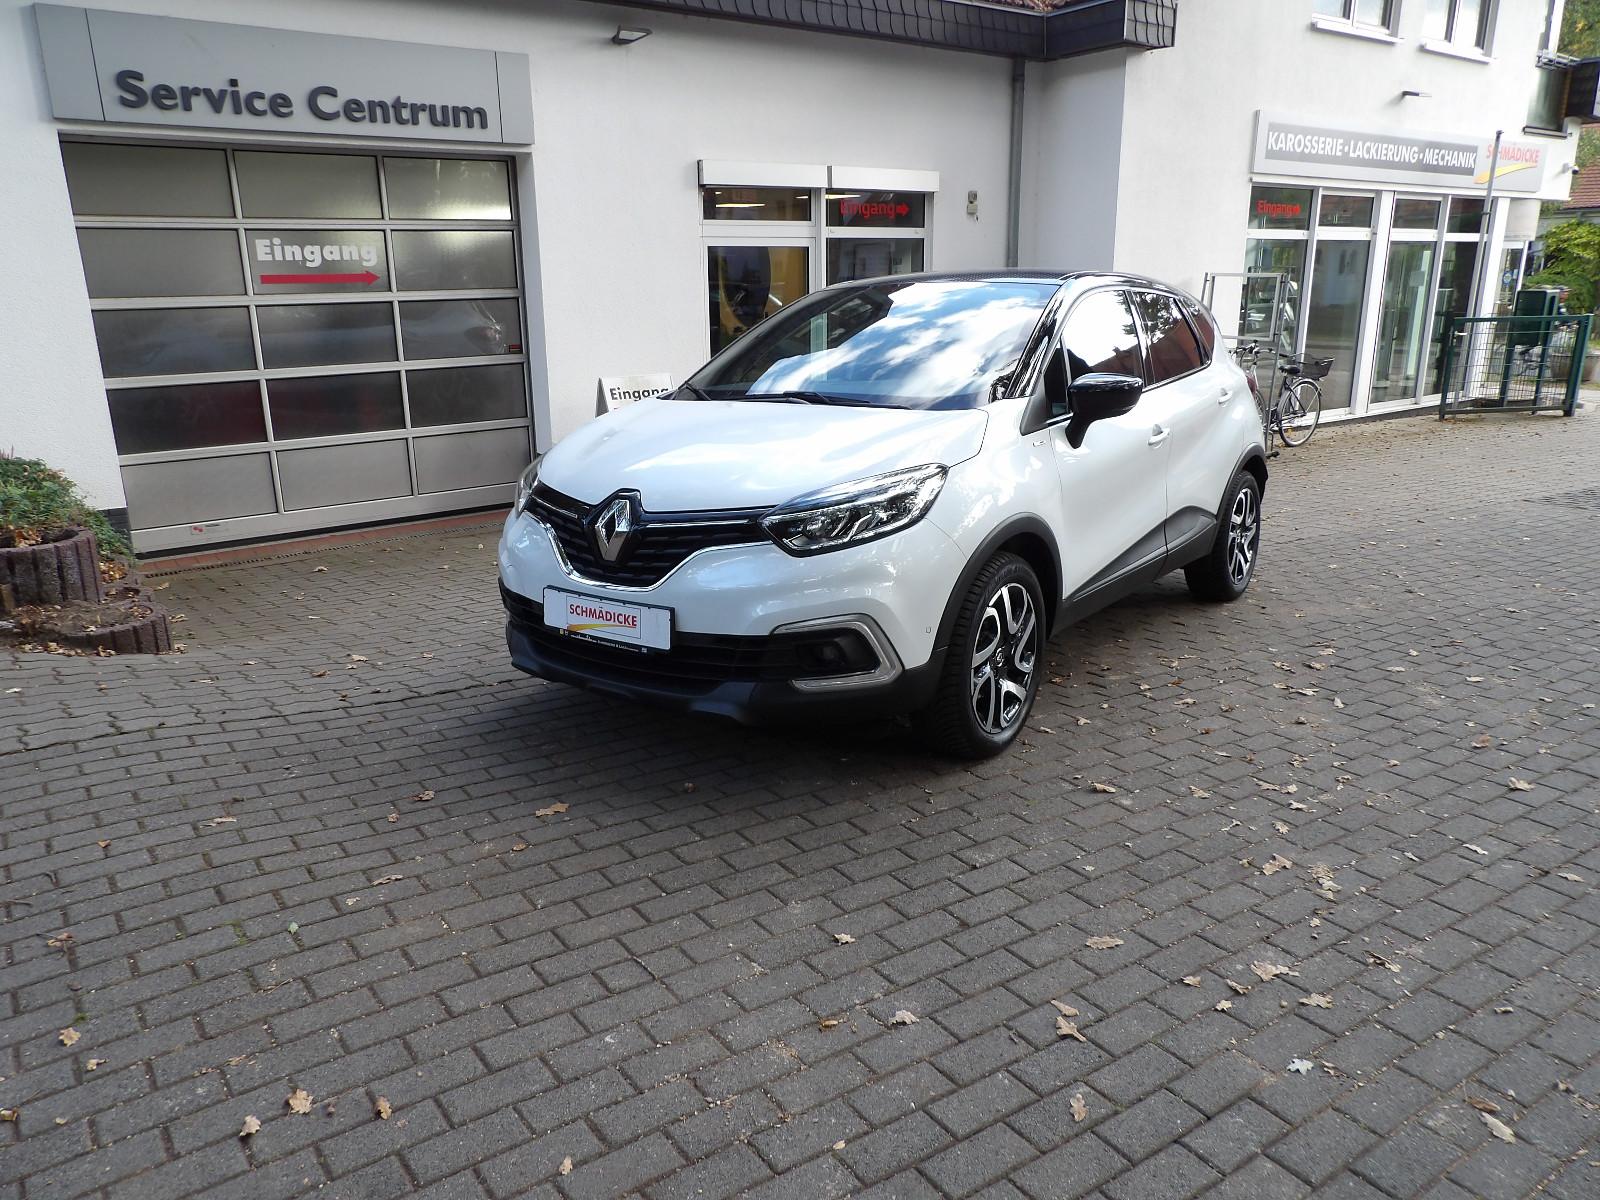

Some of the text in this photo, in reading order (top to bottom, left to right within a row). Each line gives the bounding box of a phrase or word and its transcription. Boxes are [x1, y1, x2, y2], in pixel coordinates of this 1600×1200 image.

[116, 69, 488, 129] Service Centrum
[1267, 131, 1477, 169] KAROSSERIE LACKIERUNG MECHANIK
[1486, 143, 1541, 163] SHMÄDICKE
[840, 200, 896, 218] Eingang
[255, 237, 378, 268] Eingang
[569, 603, 638, 627] SCHMÄDICKE
